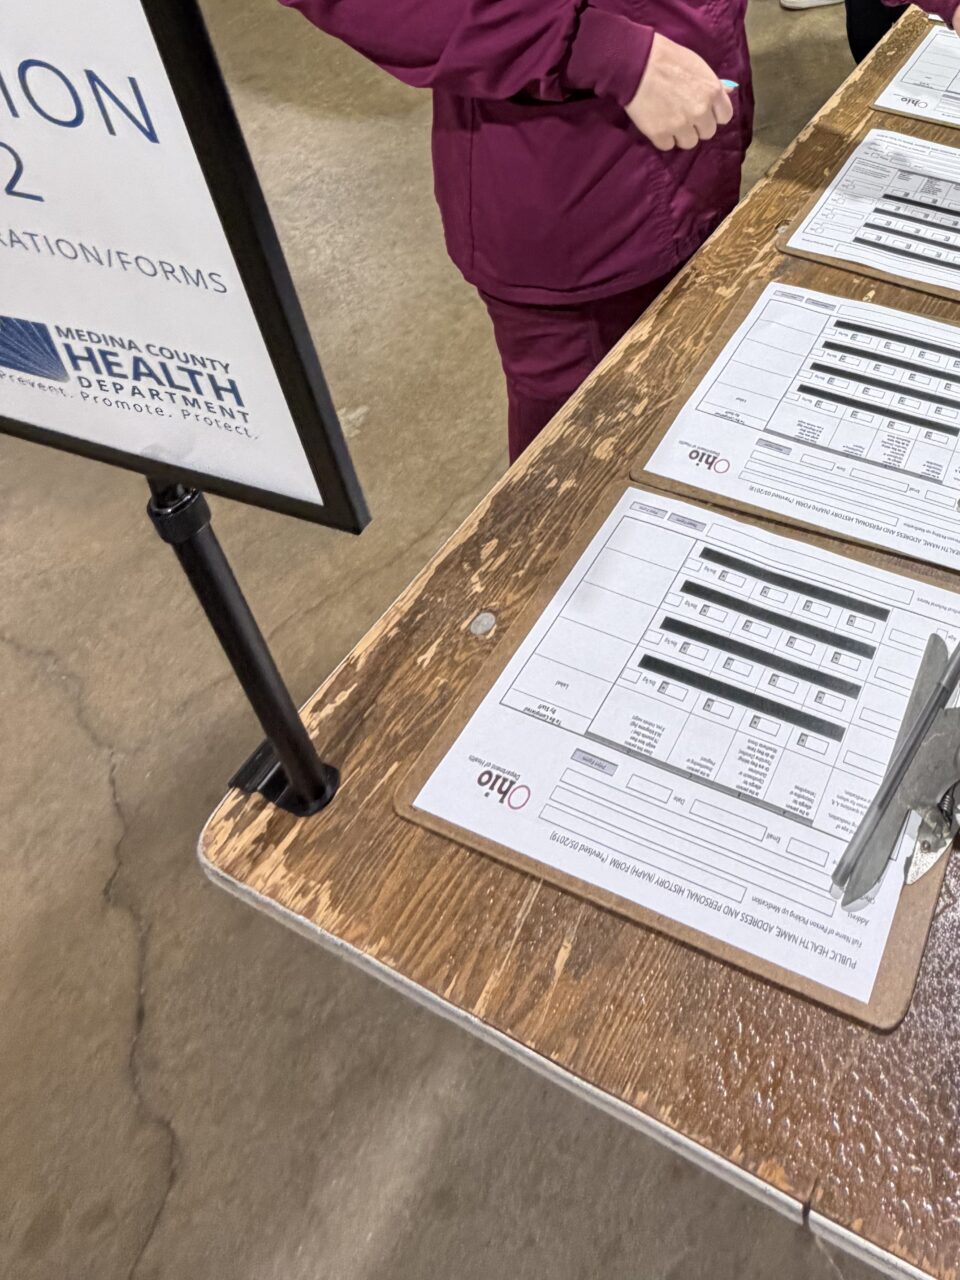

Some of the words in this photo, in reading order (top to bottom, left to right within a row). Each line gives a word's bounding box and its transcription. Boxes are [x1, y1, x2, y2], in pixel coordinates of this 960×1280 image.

[0, 141, 45, 202] 2
[0, 228, 228, 294] ATION/FORMS
[55, 324, 141, 353] MEDINA
[145, 343, 230, 375] COUNTY
[62, 342, 246, 408] HEALTH
[77, 375, 250, 424] DEPARTMENT
[80, 390, 173, 418] Promote.
[181, 408, 260, 440] Protect.
[688, 448, 731, 475] Ohio
[476, 769, 532, 811] Ohio
[608, 855, 632, 873] FORM
[628, 863, 656, 883] (NAPH)
[653, 874, 687, 897] HISTORY
[683, 887, 724, 913] PERSONAL
[720, 902, 741, 920] AND
[738, 910, 775, 935] ADDRESS
[797, 935, 830, 959] HEALTH
[828, 948, 858, 970] PUBLIC
